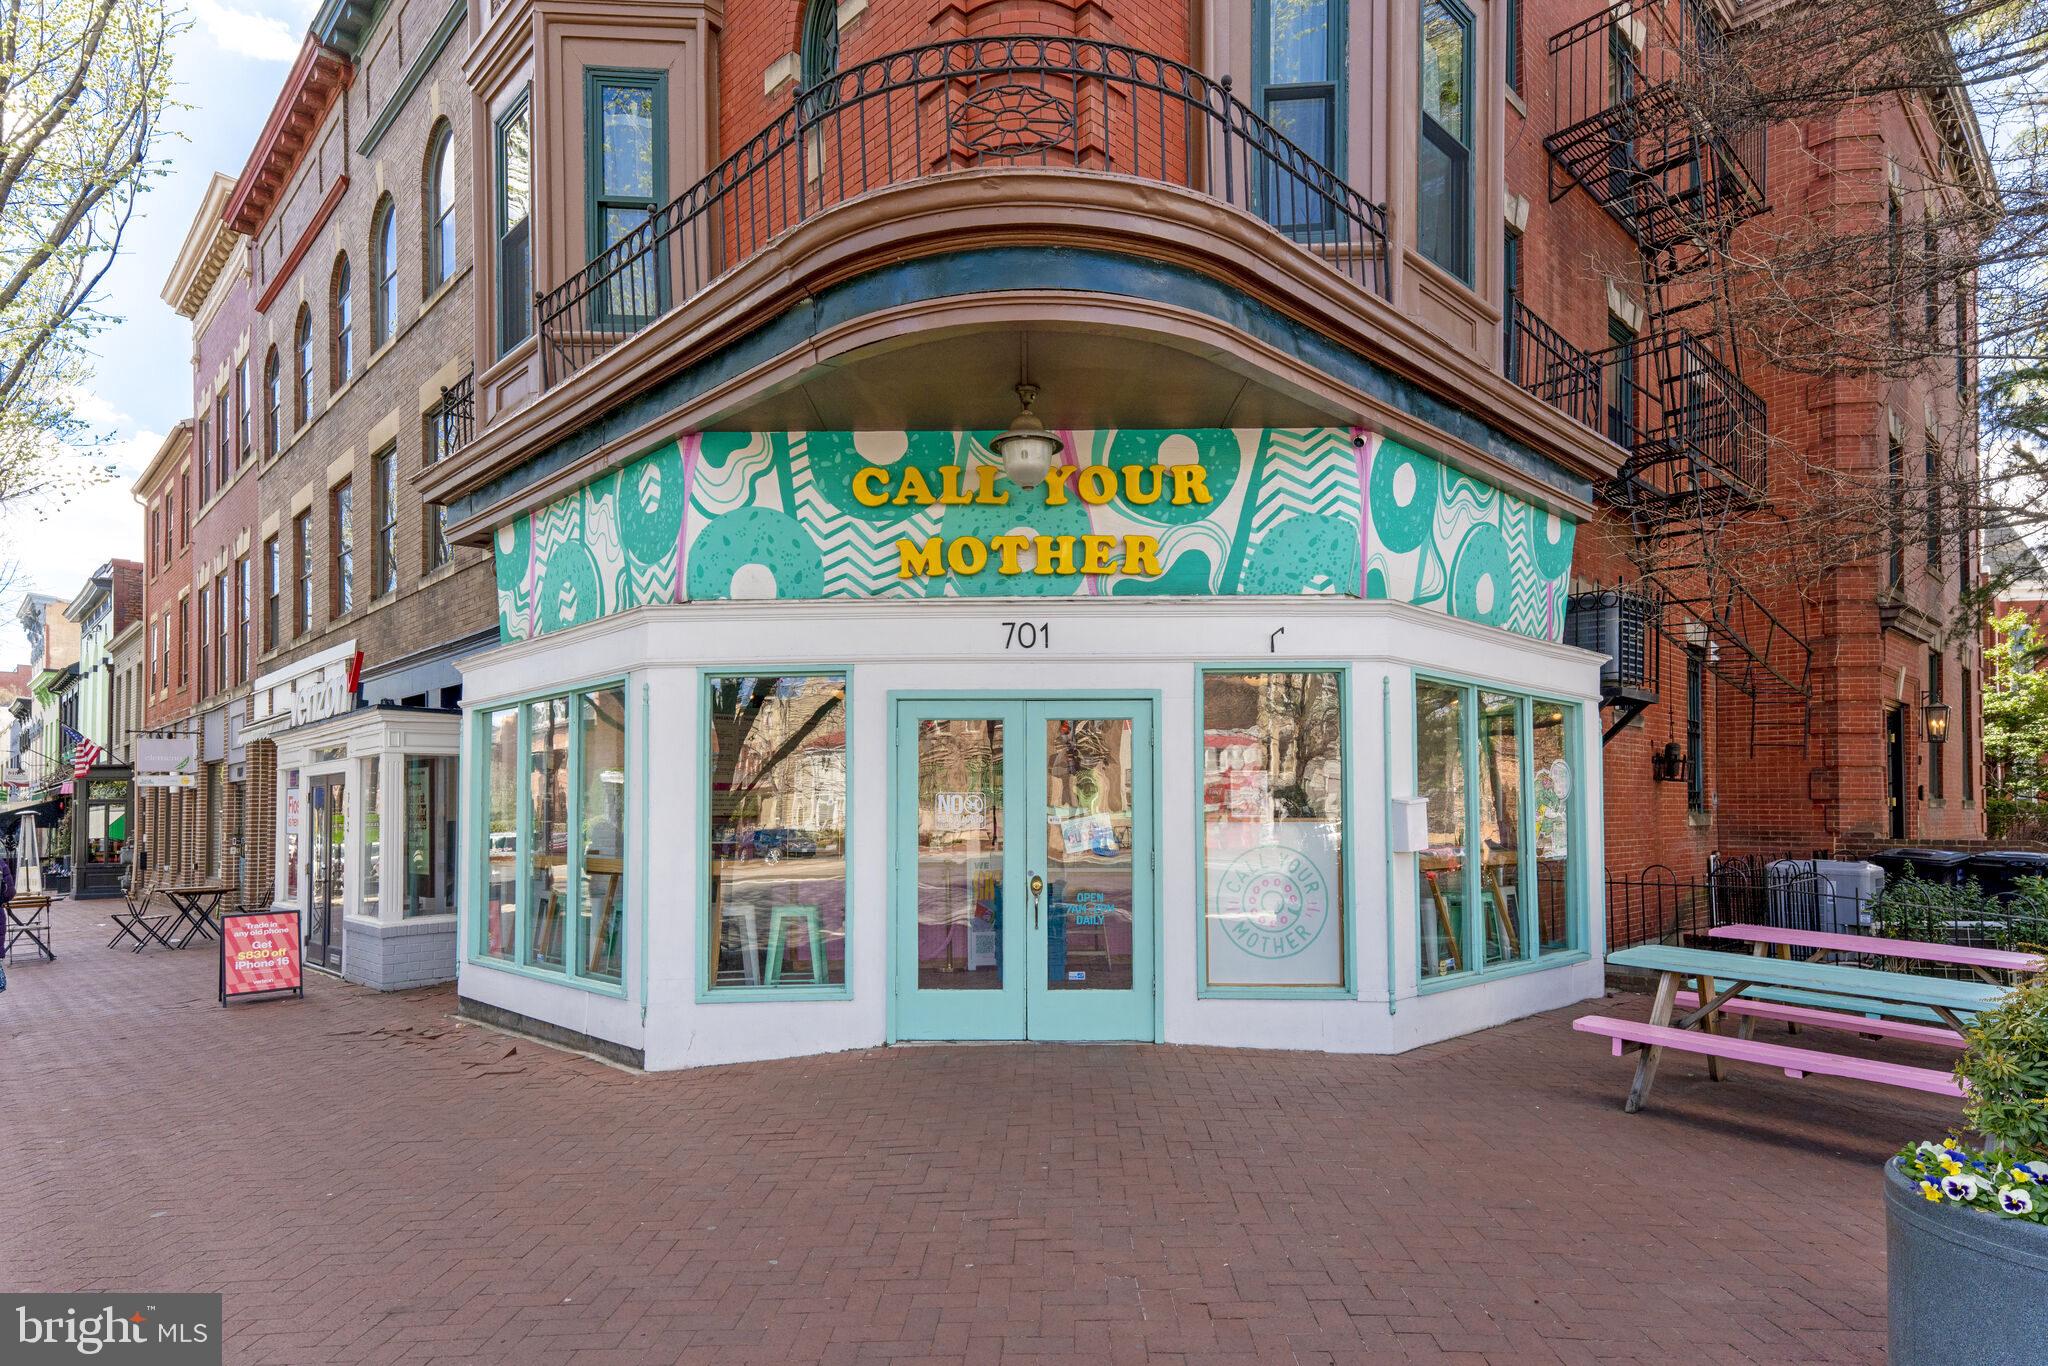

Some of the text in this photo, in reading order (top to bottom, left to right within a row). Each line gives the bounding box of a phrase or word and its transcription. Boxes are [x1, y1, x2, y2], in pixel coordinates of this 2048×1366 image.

[852, 464, 1213, 507] CALL YOUR
[895, 534, 1163, 578] MOTHER
[1002, 622, 1049, 648] 701
[937, 795, 963, 816] NO
[1226, 852, 1320, 895] CALL YOUR
[1077, 892, 1104, 902] OPEN
[1076, 915, 1105, 925] DAILY
[252, 940, 273, 950] Get
[1232, 921, 1312, 954] MOTHER
[235, 957, 290, 970] iPhone 16
[238, 947, 287, 960] $830 off
